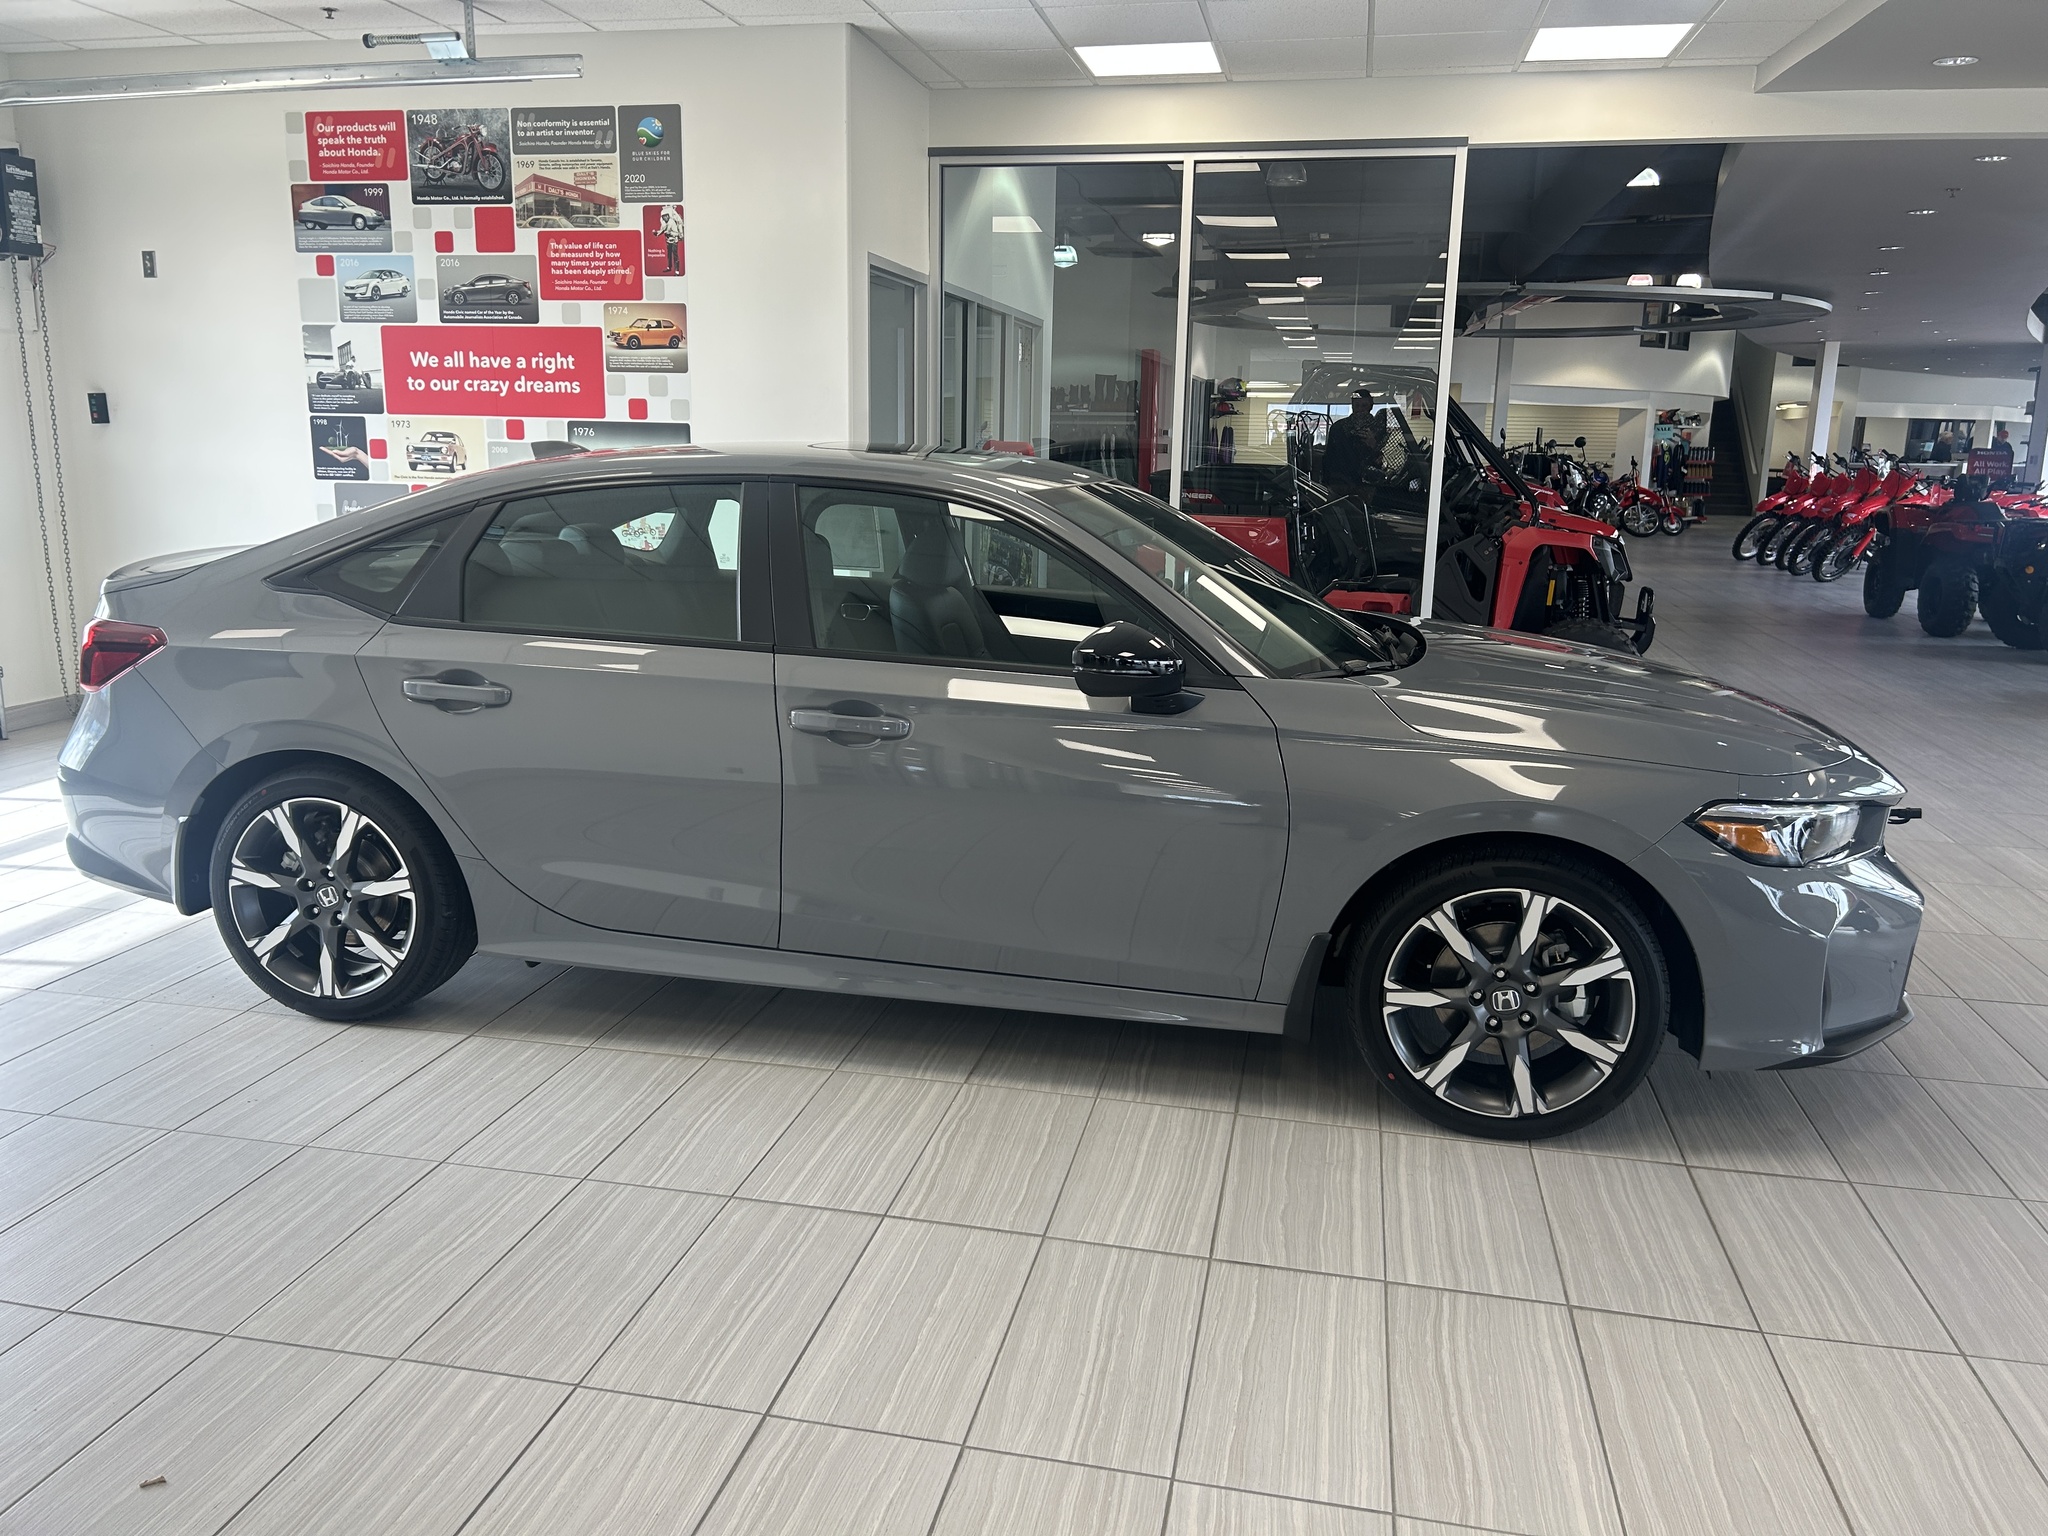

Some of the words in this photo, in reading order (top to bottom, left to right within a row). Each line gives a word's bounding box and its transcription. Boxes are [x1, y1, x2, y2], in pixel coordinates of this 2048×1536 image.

[412, 114, 438, 125] 1948
[533, 120, 571, 128] conformity
[579, 118, 609, 126] essential
[317, 123, 334, 132] Our
[337, 122, 377, 134] products
[379, 122, 396, 131] will
[318, 136, 345, 146] speak
[347, 135, 362, 144] the
[364, 136, 386, 144] truth
[319, 148, 345, 157] about
[348, 147, 381, 156] Honda.
[625, 174, 646, 183] 2020
[364, 188, 383, 196] 1999
[548, 187, 564, 196] DALT'S
[596, 251, 604, 259] by
[340, 259, 359, 267] 2016
[441, 259, 460, 267] 2016
[583, 268, 606, 276] deeply
[608, 307, 628, 315] 1974
[410, 352, 439, 368] We
[444, 351, 464, 368] all
[470, 351, 511, 369] have
[516, 357, 526, 369] a
[532, 352, 575, 374] right
[407, 377, 425, 391] to
[430, 379, 459, 391] our
[464, 379, 510, 397] crazy
[514, 376, 581, 393] dreams
[573, 428, 595, 436] 1976
